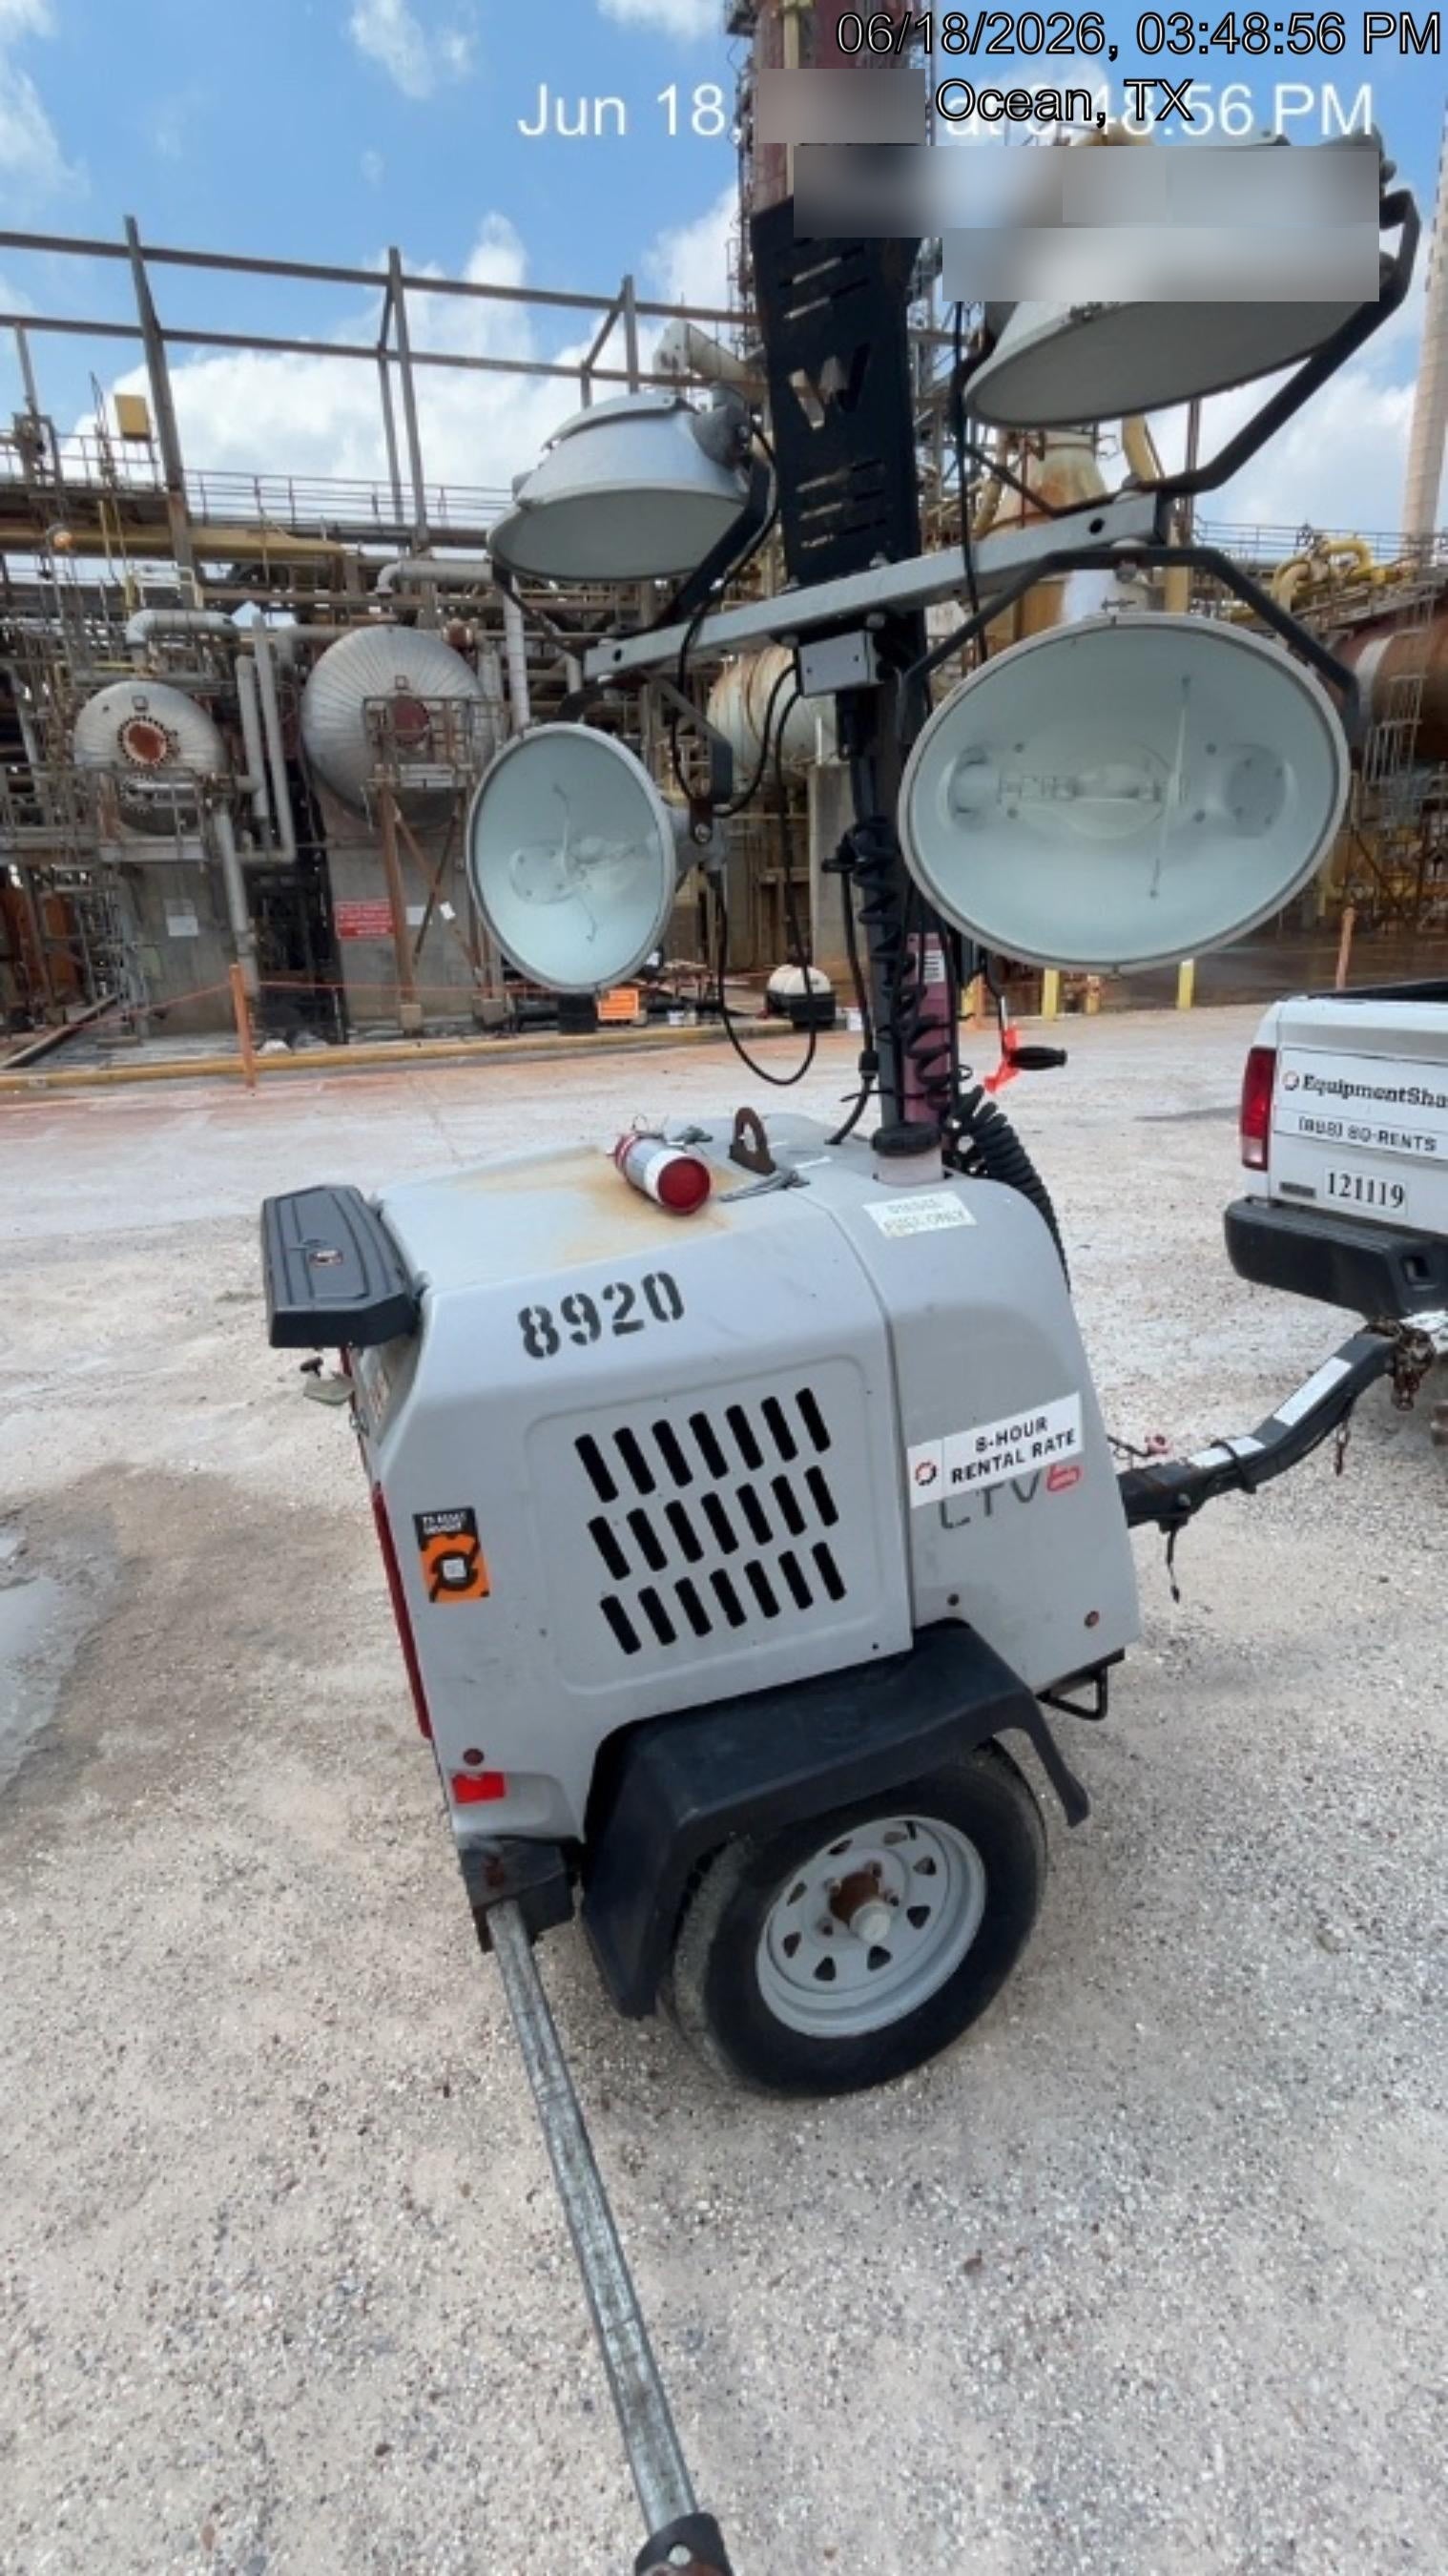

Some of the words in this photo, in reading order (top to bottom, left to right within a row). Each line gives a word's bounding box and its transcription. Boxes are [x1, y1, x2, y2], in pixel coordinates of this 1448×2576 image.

[1329, 1172, 1405, 1208] 121119
[518, 1271, 685, 1359] 8920
[951, 1448, 1025, 1484] RENTAL
[1031, 1427, 1076, 1459] RATE
[975, 1416, 1047, 1453] 8-HOUR
